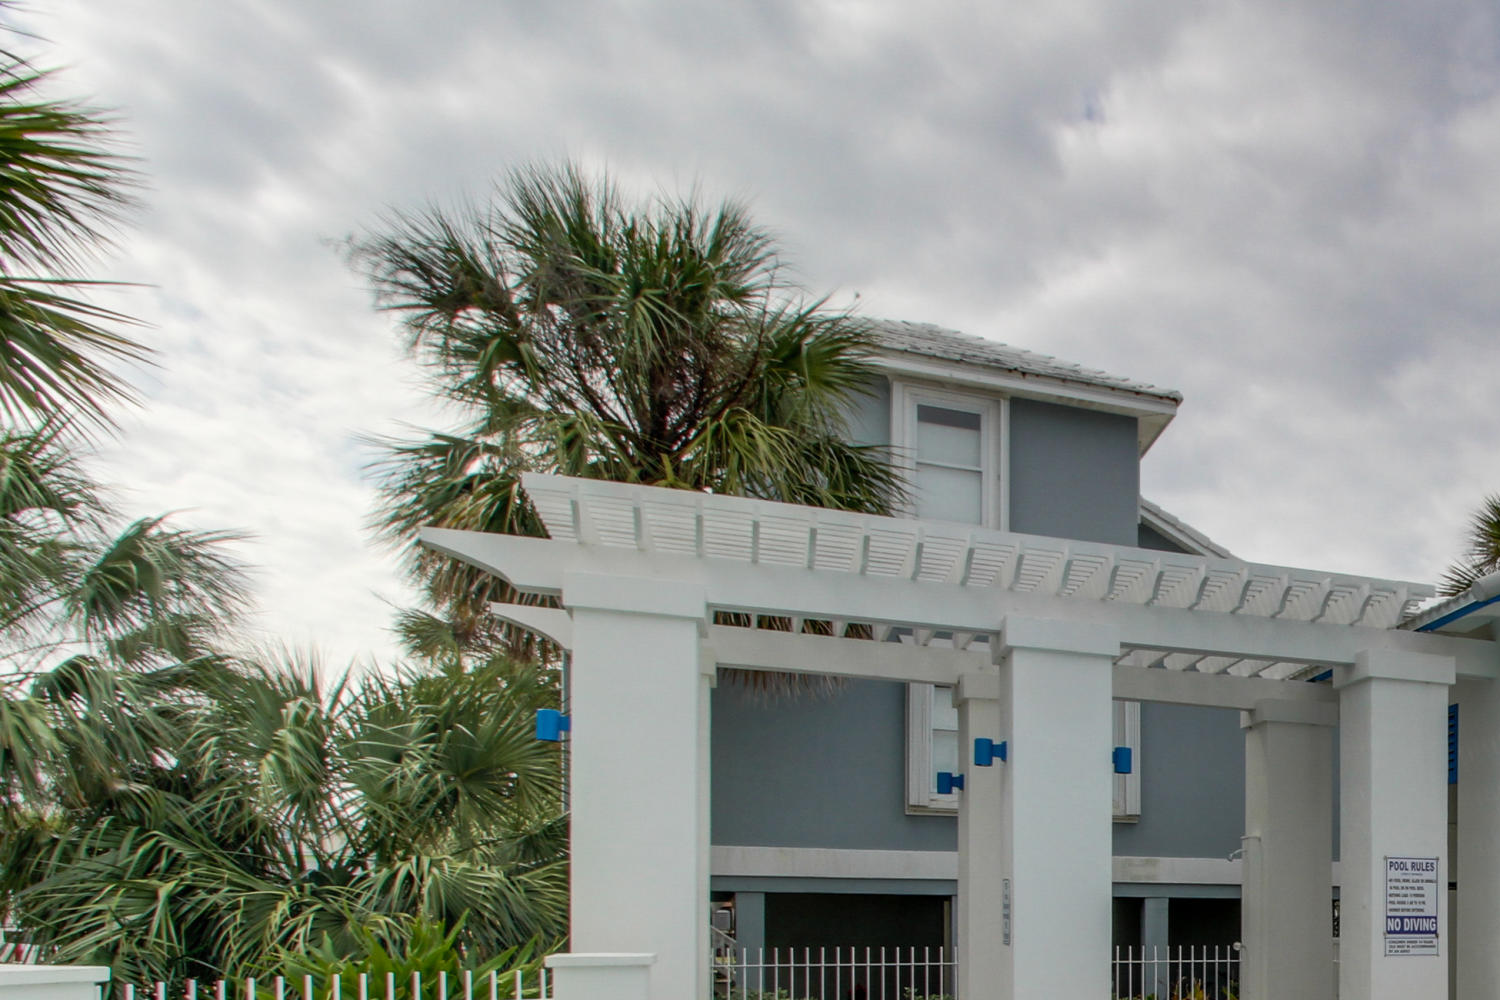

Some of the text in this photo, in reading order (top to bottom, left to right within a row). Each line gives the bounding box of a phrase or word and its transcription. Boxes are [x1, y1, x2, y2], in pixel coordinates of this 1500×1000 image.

[1389, 861, 1435, 872] POOL RULES
[1387, 918, 1436, 931] NO DIVING
